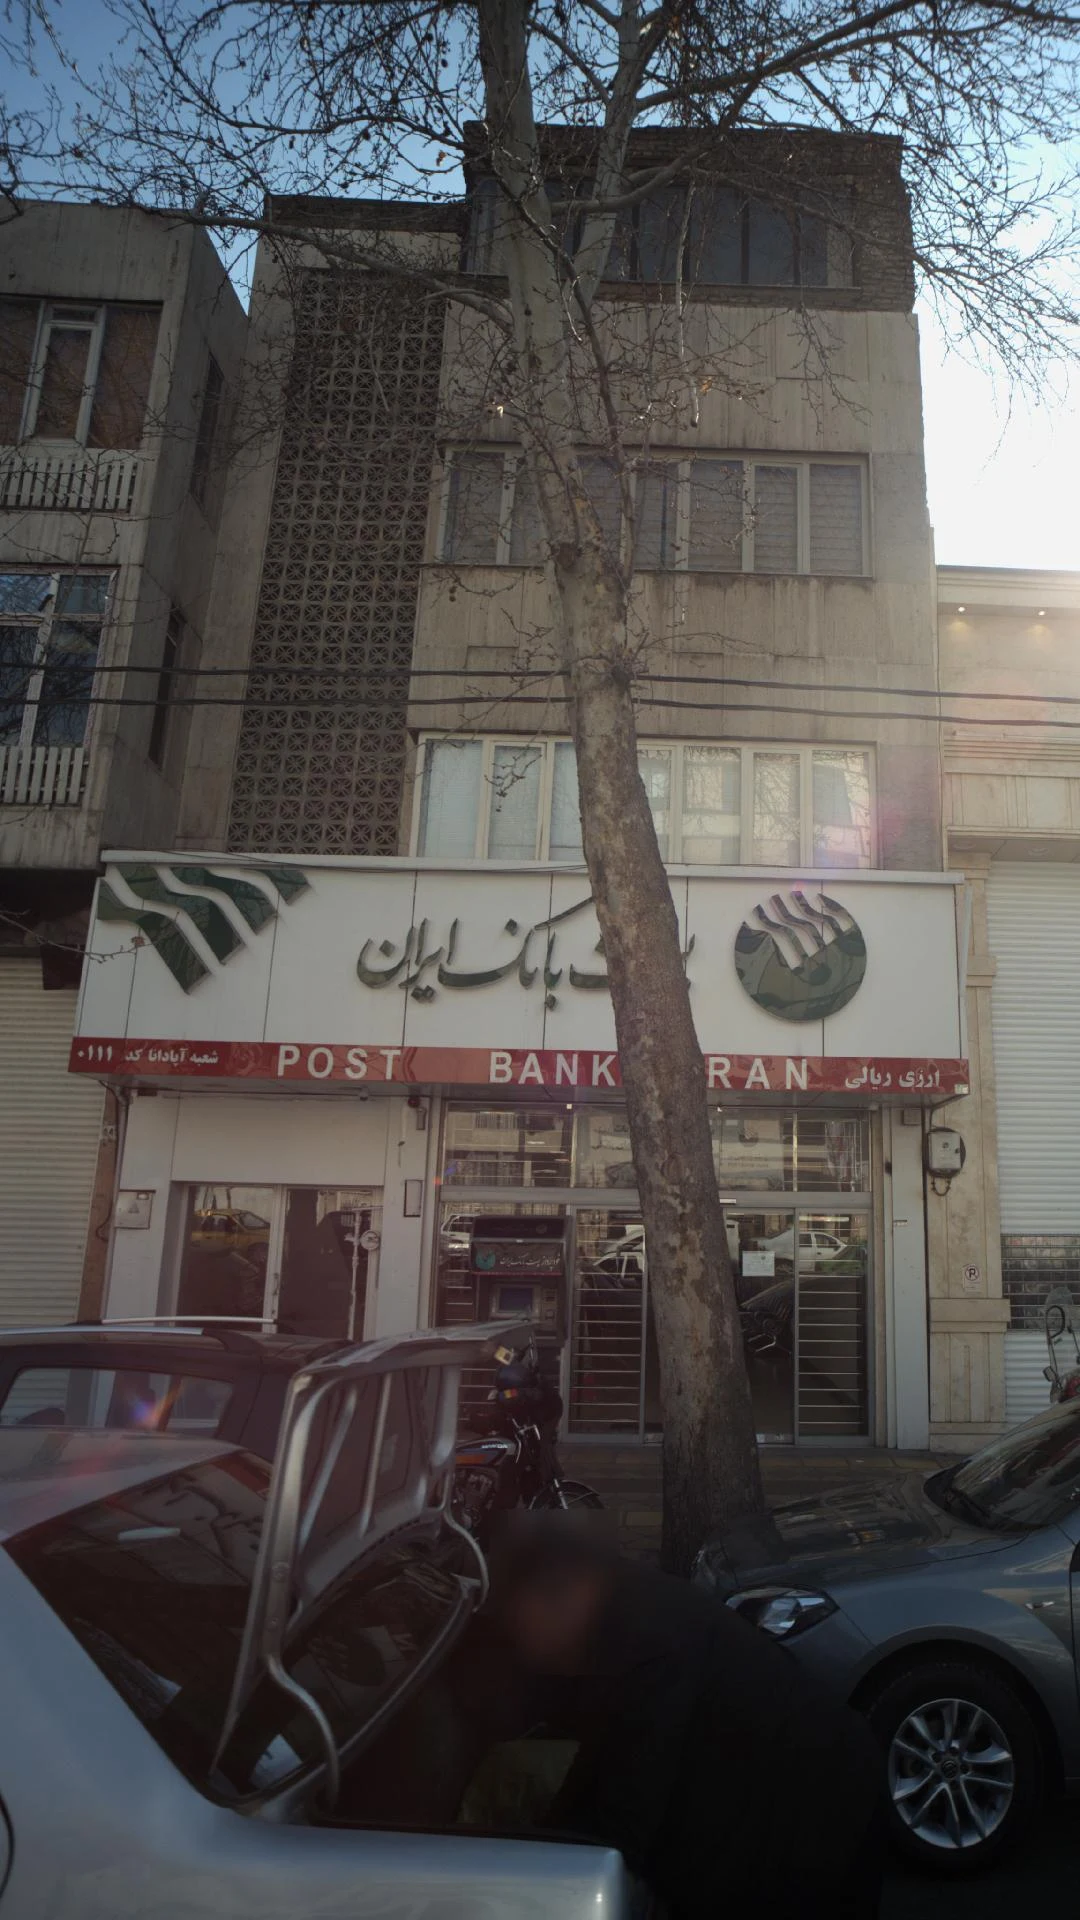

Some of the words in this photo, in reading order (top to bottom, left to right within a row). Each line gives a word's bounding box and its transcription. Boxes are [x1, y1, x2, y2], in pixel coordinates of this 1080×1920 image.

[356, 917, 459, 1003] ایران
[77, 1044, 113, 1062] ۰۱۱۱
[124, 1048, 143, 1062] کد
[148, 1047, 189, 1067] آپادانا
[190, 1051, 219, 1066] شعبه
[277, 1044, 401, 1081] POST
[489, 1051, 617, 1088] BANK
[707, 1055, 809, 1091] RAN
[845, 1066, 892, 1090] ریالی
[898, 1069, 940, 1089] ارزی
